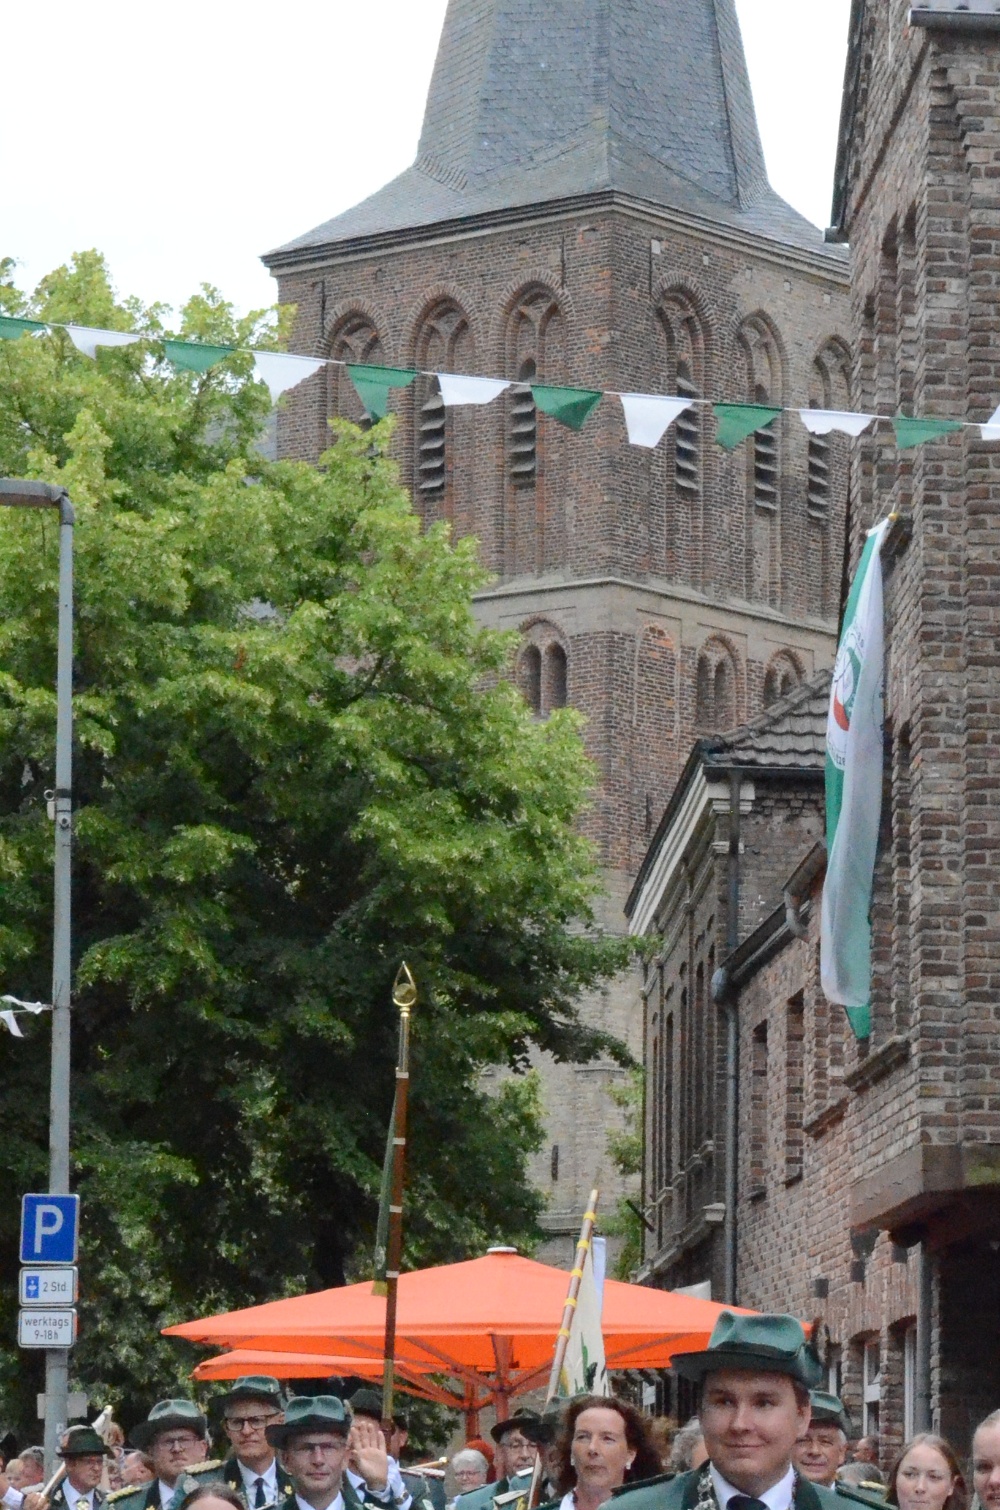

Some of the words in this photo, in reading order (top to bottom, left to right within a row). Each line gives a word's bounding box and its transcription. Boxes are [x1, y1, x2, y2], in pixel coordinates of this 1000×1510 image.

[34, 1205, 63, 1253] P
[43, 1282, 48, 1292] 2
[51, 1282, 68, 1292] Std.
[24, 1317, 69, 1329] werktags
